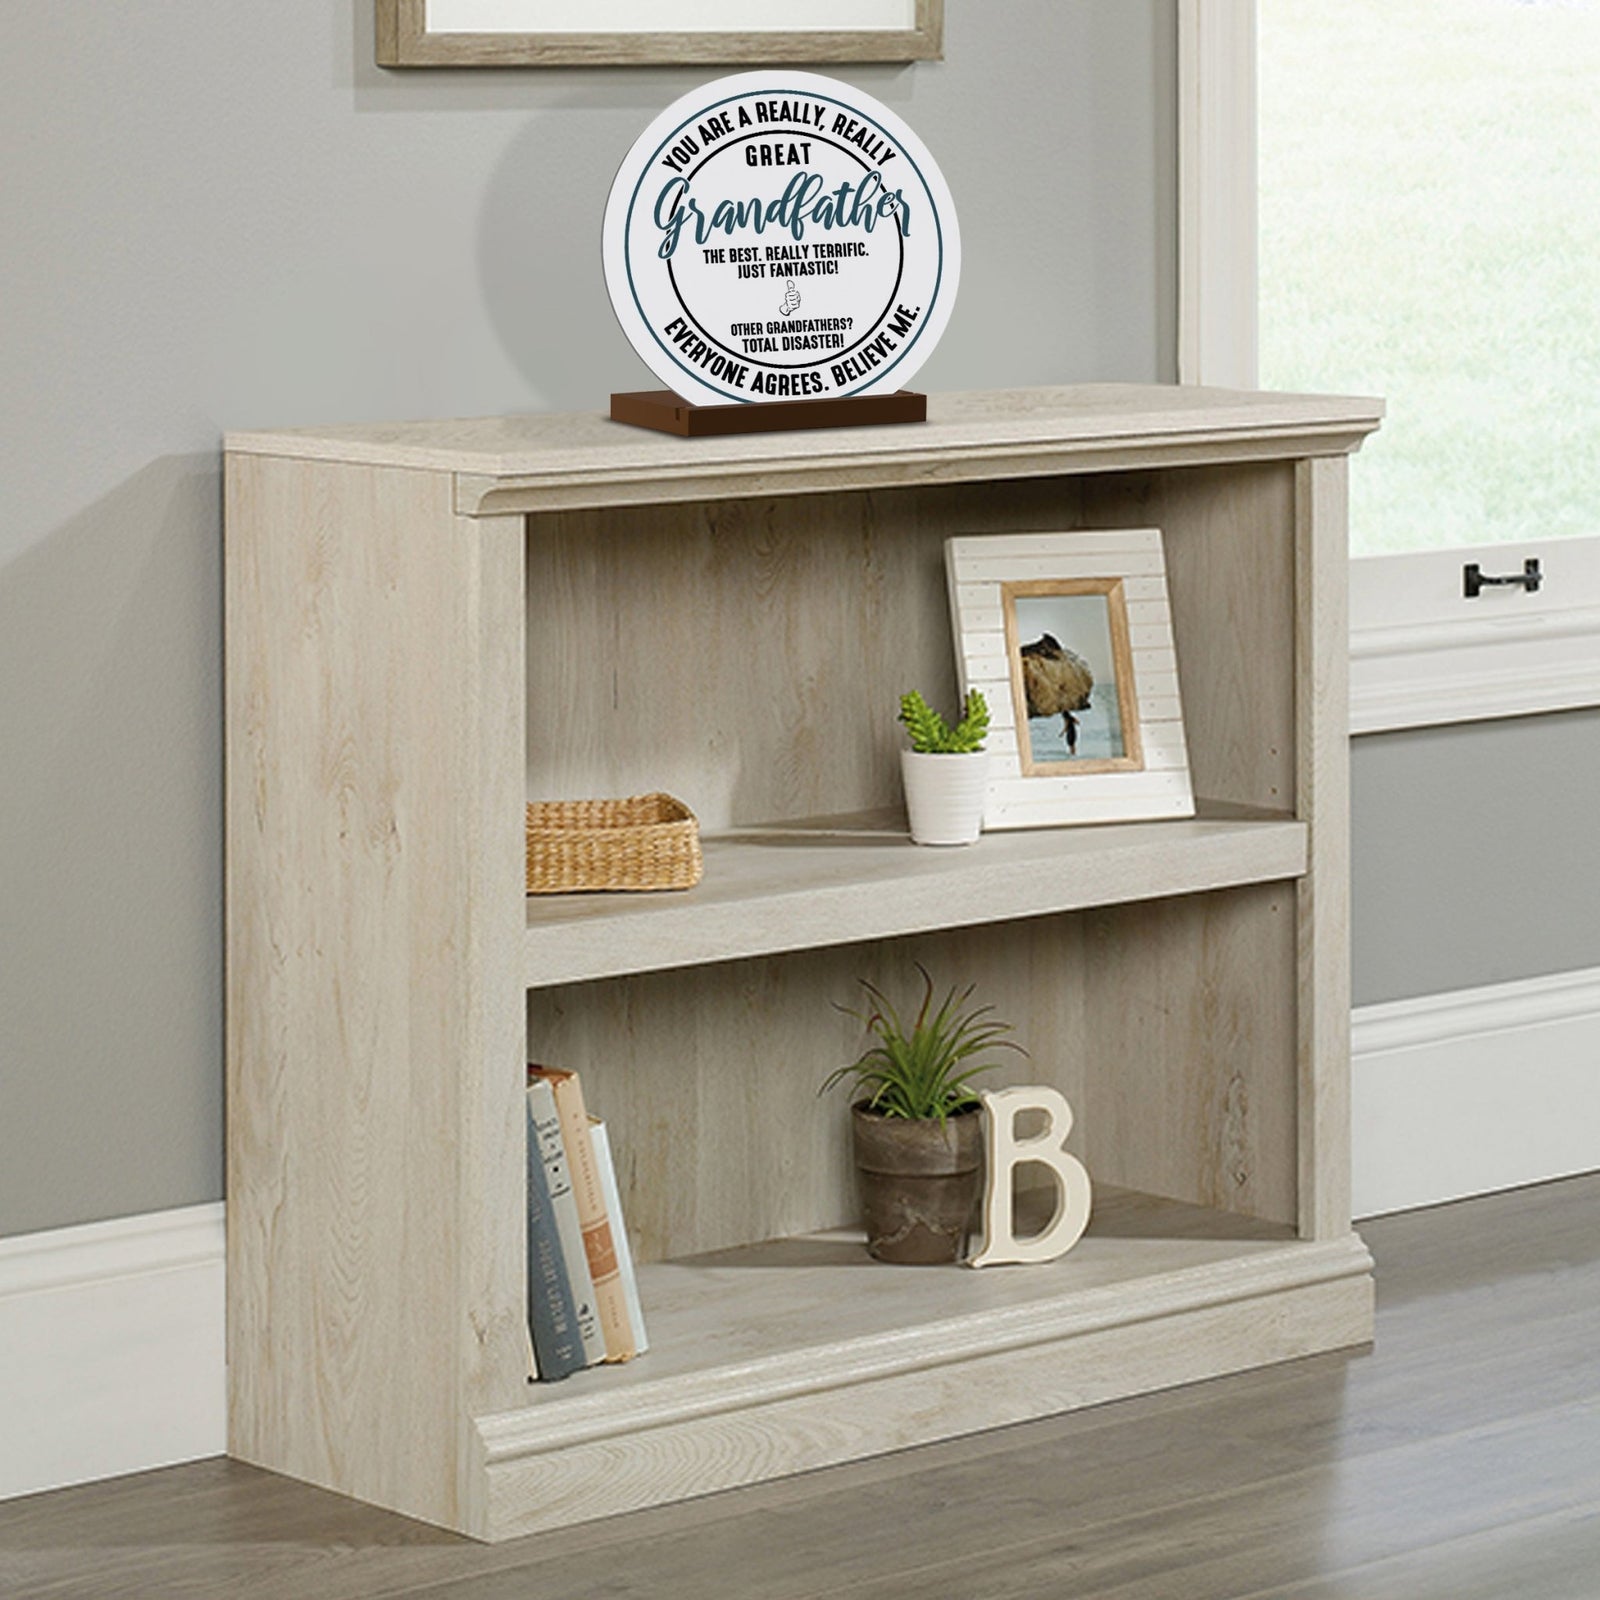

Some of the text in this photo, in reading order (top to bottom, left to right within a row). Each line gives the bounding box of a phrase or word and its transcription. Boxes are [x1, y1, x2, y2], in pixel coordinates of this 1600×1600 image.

[662, 100, 896, 172] YOU ARE A REALLY, REALLY
[746, 143, 811, 166] GREAT
[653, 171, 911, 260] Grandfather
[703, 242, 870, 264] THE BEST. REALLY TERRIFIC.
[738, 261, 839, 279] JUST FANTASTIC!
[731, 317, 854, 337] OTHER GRANDFATHERS?
[664, 304, 921, 396] EVERYONE AGREES. BELIEVE ME.
[742, 333, 845, 354] TOTAL DISASTER!
[967, 1085, 1092, 1269] B
